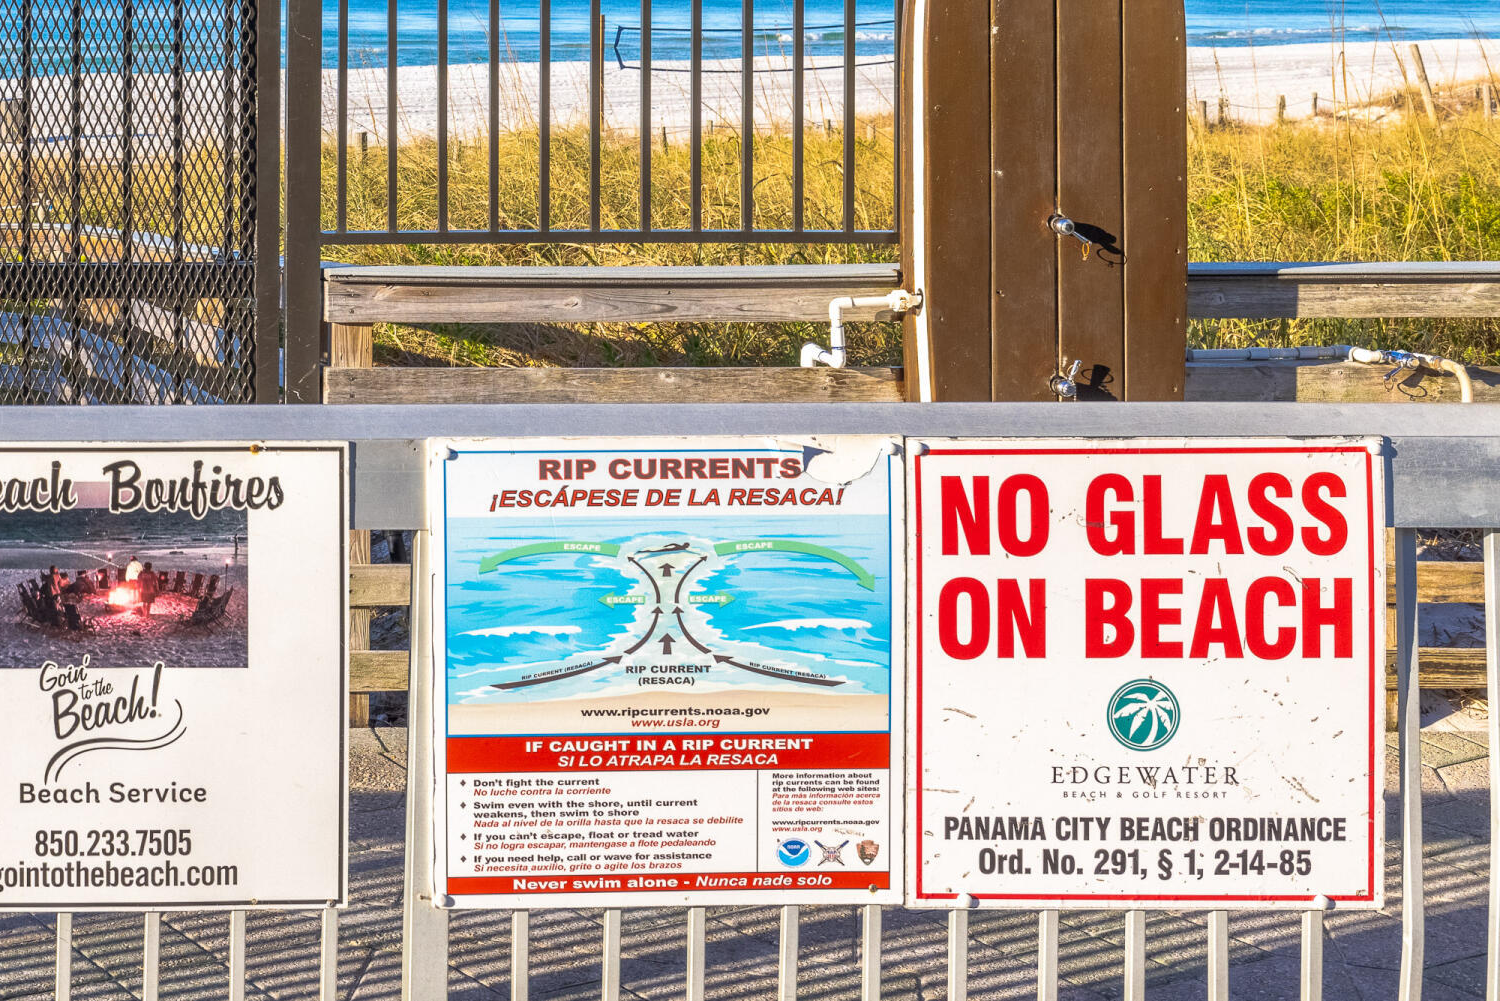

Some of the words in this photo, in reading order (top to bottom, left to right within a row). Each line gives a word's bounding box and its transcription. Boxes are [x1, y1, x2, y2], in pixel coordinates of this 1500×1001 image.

[539, 459, 597, 480] RIP
[608, 458, 802, 480] CURRENTS
[103, 460, 285, 518] Bonfires
[490, 485, 639, 512] ¡ESCÁPESE
[645, 489, 682, 506] DE
[688, 489, 721, 506] LA
[728, 488, 844, 506] RESACA!
[940, 474, 1050, 557] NO
[1086, 472, 1348, 556] GLASS
[564, 543, 601, 552] ESCAPE
[736, 542, 773, 551] ESCAPE
[606, 596, 644, 604] ESCAPE
[938, 576, 1047, 660] ON
[1085, 576, 1353, 660] BEACH
[40, 656, 88, 691] Goin'
[534, 668, 563, 679] CURRENT
[564, 661, 593, 673] (RESACA)
[626, 666, 646, 674] RIP
[651, 665, 711, 674] CURRENT
[762, 664, 794, 676] CURRENT
[795, 670, 827, 680] (RESACA)
[638, 677, 695, 686] (RESACA)
[78, 684, 93, 700] to
[92, 677, 113, 696] the
[52, 663, 162, 739] Beach!
[581, 707, 770, 718] www.ripcurrents.noaa.gov
[632, 718, 720, 728] www.usla.org
[526, 742, 543, 753] IF
[549, 740, 631, 752] CAUGHT
[636, 740, 657, 751] IN
[662, 740, 677, 751] A
[682, 740, 714, 751] RIP
[720, 738, 814, 750] CURRENT
[558, 756, 575, 767] SI
[578, 756, 603, 767] LO
[606, 754, 675, 767] ATRAPA
[680, 754, 702, 766] LA
[706, 754, 779, 765] RESACA
[1051, 766, 1240, 786] EDGEWATER
[474, 779, 502, 787] Don't
[506, 779, 532, 788] fight
[536, 778, 554, 786] the
[558, 778, 599, 786] current
[18, 783, 100, 804] Beach
[109, 782, 207, 804] Service
[474, 788, 487, 796] No
[490, 788, 517, 796] luche
[520, 788, 552, 796] contra
[567, 787, 611, 795] corriente
[1063, 790, 1106, 799] BEACH
[1116, 790, 1124, 799] &
[1132, 790, 1167, 799] GOLF
[1176, 790, 1228, 799] RESORT
[474, 801, 504, 809] Swim
[588, 800, 624, 809] shore,
[656, 799, 698, 807] current
[474, 811, 528, 819] weakens,
[531, 810, 556, 818] then
[474, 820, 499, 828] Nada
[594, 818, 621, 826] hasta
[624, 819, 643, 827] que
[707, 816, 744, 824] debilite
[944, 816, 1047, 841] PANAMA
[1056, 816, 1111, 841] CITY
[1120, 817, 1200, 842] BEACH
[1209, 817, 1347, 842] ORDINANCE
[474, 833, 483, 841] If
[486, 834, 506, 842] you
[510, 832, 537, 840] can't
[540, 833, 585, 841] escape,
[666, 830, 699, 838] water
[34, 829, 191, 857] 850.233.7505
[474, 842, 484, 850] Si
[500, 842, 525, 851] logra
[528, 842, 567, 850] escapar,
[569, 840, 628, 850] mantengase
[661, 838, 717, 848] pedaleando
[485, 856, 505, 864] you
[538, 854, 564, 863] help,
[653, 852, 712, 860] assistance
[978, 848, 1031, 875] Ord.
[1042, 848, 1084, 875] No.
[1094, 850, 1148, 880] 291,
[1158, 849, 1173, 880] §
[1184, 850, 1204, 880] 1,
[1214, 849, 1312, 876] 2-14-85
[474, 864, 484, 872] Si
[486, 864, 528, 872] necesita
[570, 864, 592, 872] grite
[604, 862, 629, 871] agite
[648, 861, 682, 869] brazos
[512, 878, 567, 891] Never
[572, 878, 621, 889] swim
[628, 876, 678, 888] alone
[696, 876, 748, 887] Nunca
[753, 875, 792, 886] nade
[797, 874, 832, 886] solo
